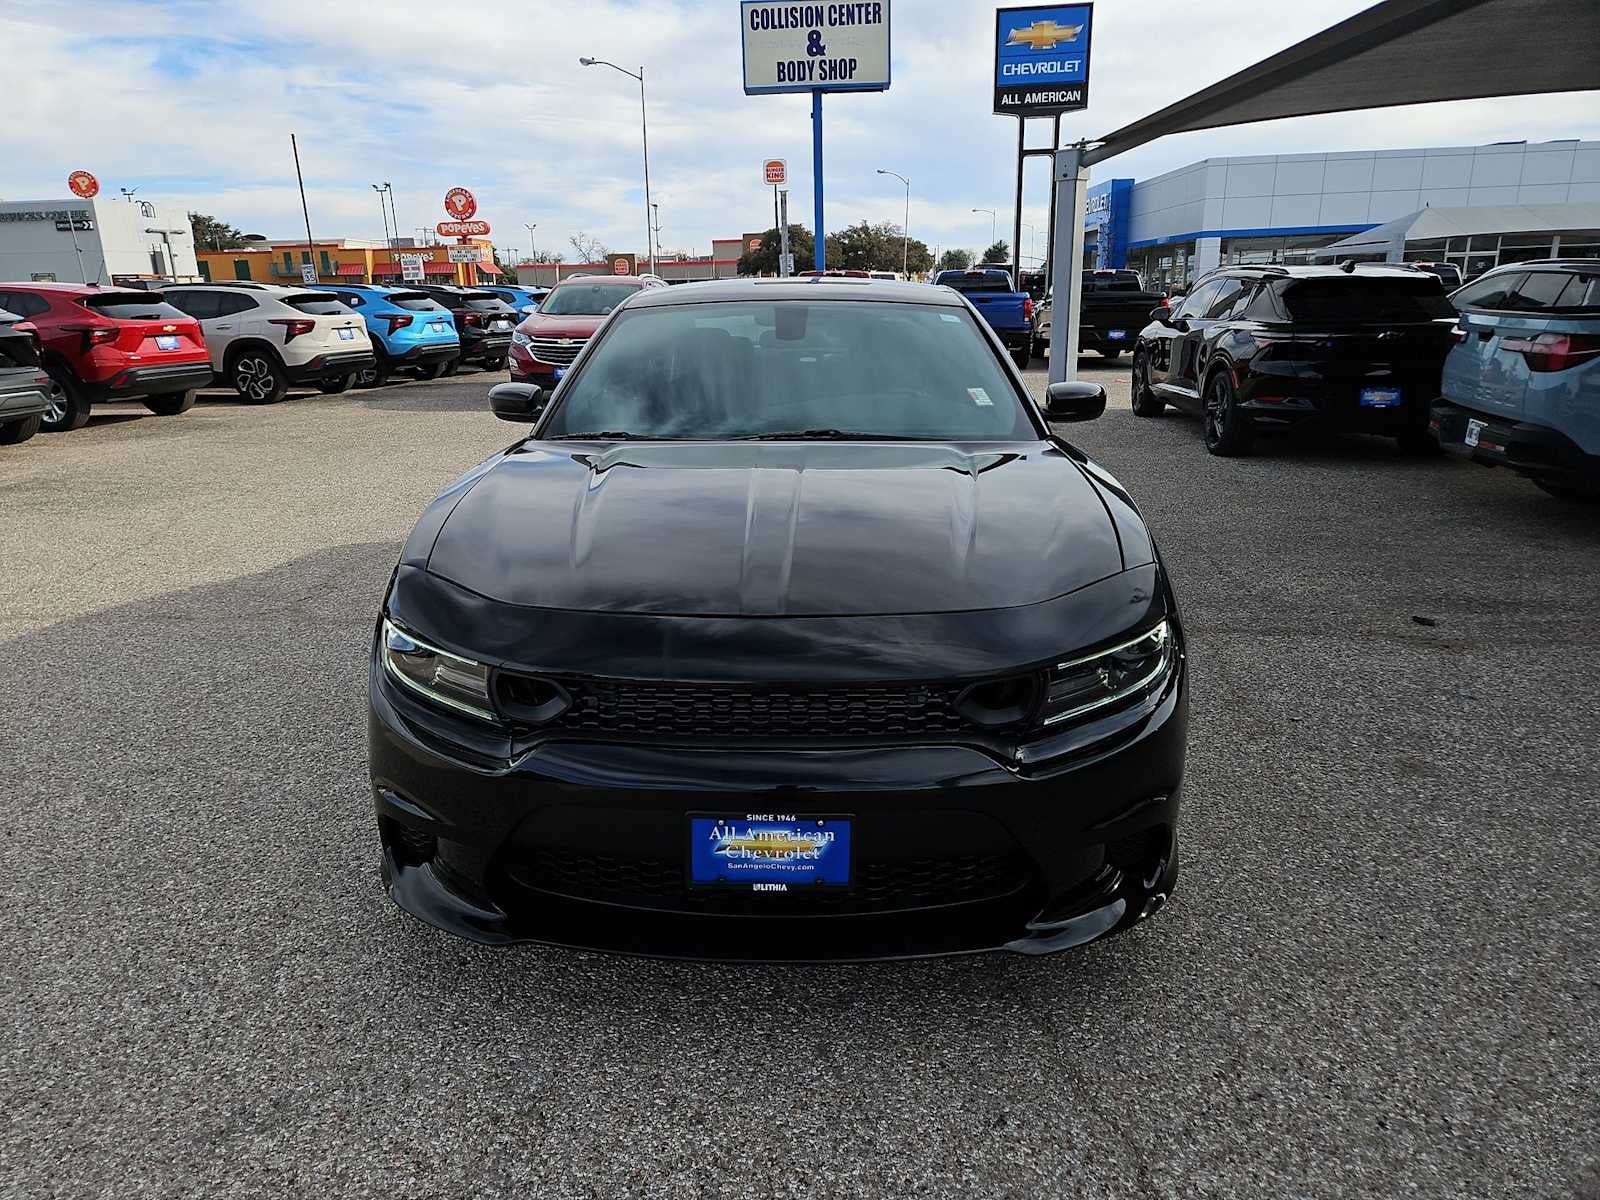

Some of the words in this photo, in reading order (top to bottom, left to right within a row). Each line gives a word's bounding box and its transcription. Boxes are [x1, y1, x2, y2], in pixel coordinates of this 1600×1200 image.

[750, 6, 824, 31] COLLISION
[828, 2, 882, 26] CENTER
[806, 29, 826, 57] &
[776, 60, 815, 82] BODY
[818, 58, 857, 81] SHOP
[1003, 59, 1081, 76] CHEVROLET
[1001, 94, 1021, 105] ALL
[1024, 90, 1081, 104] AMERICAN
[766, 171, 785, 179] KING
[440, 222, 485, 234] POPEYES
[304, 274, 315, 282] 35
[776, 814, 796, 822] 1946
[709, 826, 736, 841] All
[745, 827, 835, 842] American
[725, 845, 820, 860] Chevrolet
[727, 862, 815, 871] SanAngeloChevy.com
